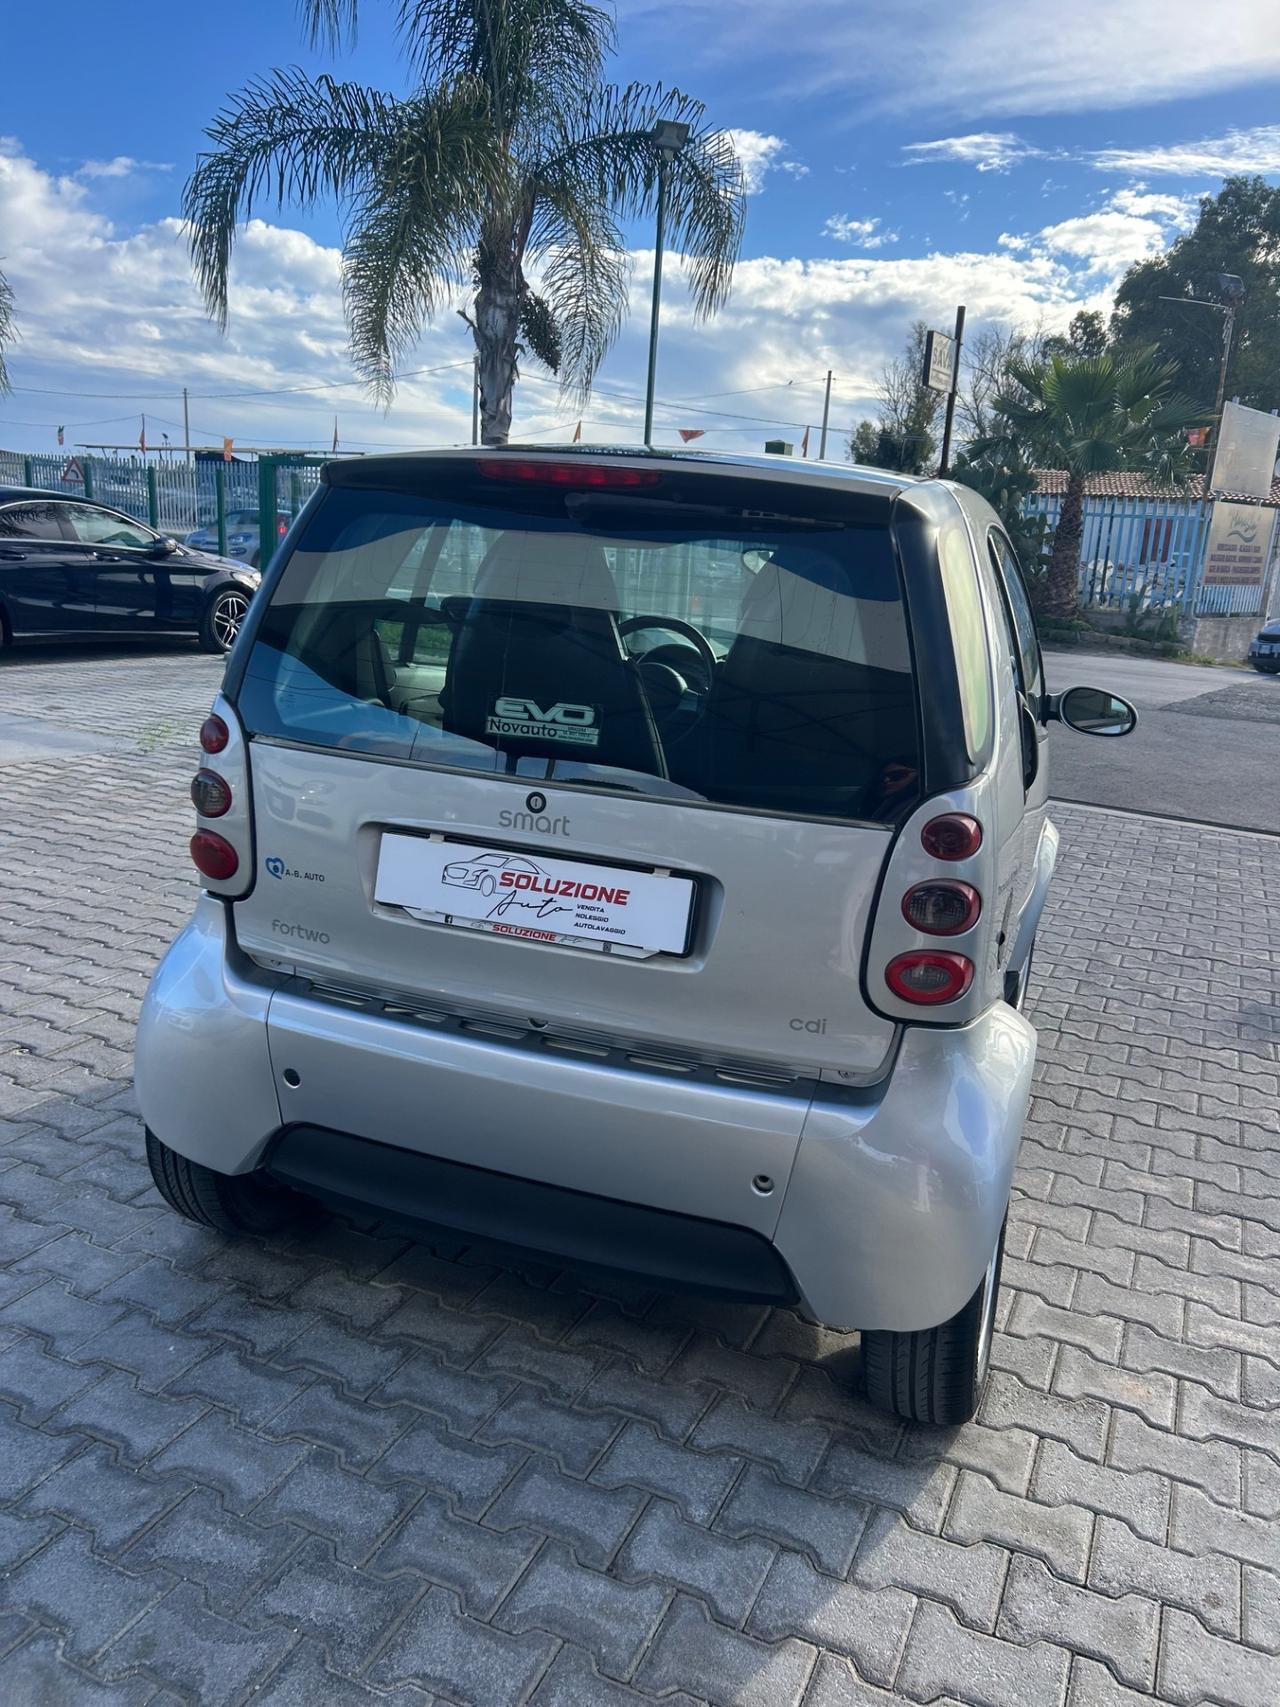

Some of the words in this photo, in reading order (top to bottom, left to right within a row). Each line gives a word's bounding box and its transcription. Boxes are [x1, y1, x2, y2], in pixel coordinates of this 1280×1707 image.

[495, 697, 595, 726] EVO
[489, 718, 557, 737] Novauto
[498, 810, 571, 837] smart
[304, 872, 325, 882] AUTO
[499, 872, 630, 906] SOLUZIONE
[486, 890, 574, 918] Auto
[576, 904, 605, 913] VENDITA
[575, 912, 609, 923] NOLEGGIO
[492, 924, 557, 941] SOLUZIONE
[573, 922, 626, 935] AUTOLAVAGGIO
[789, 1018, 827, 1035] cdi
